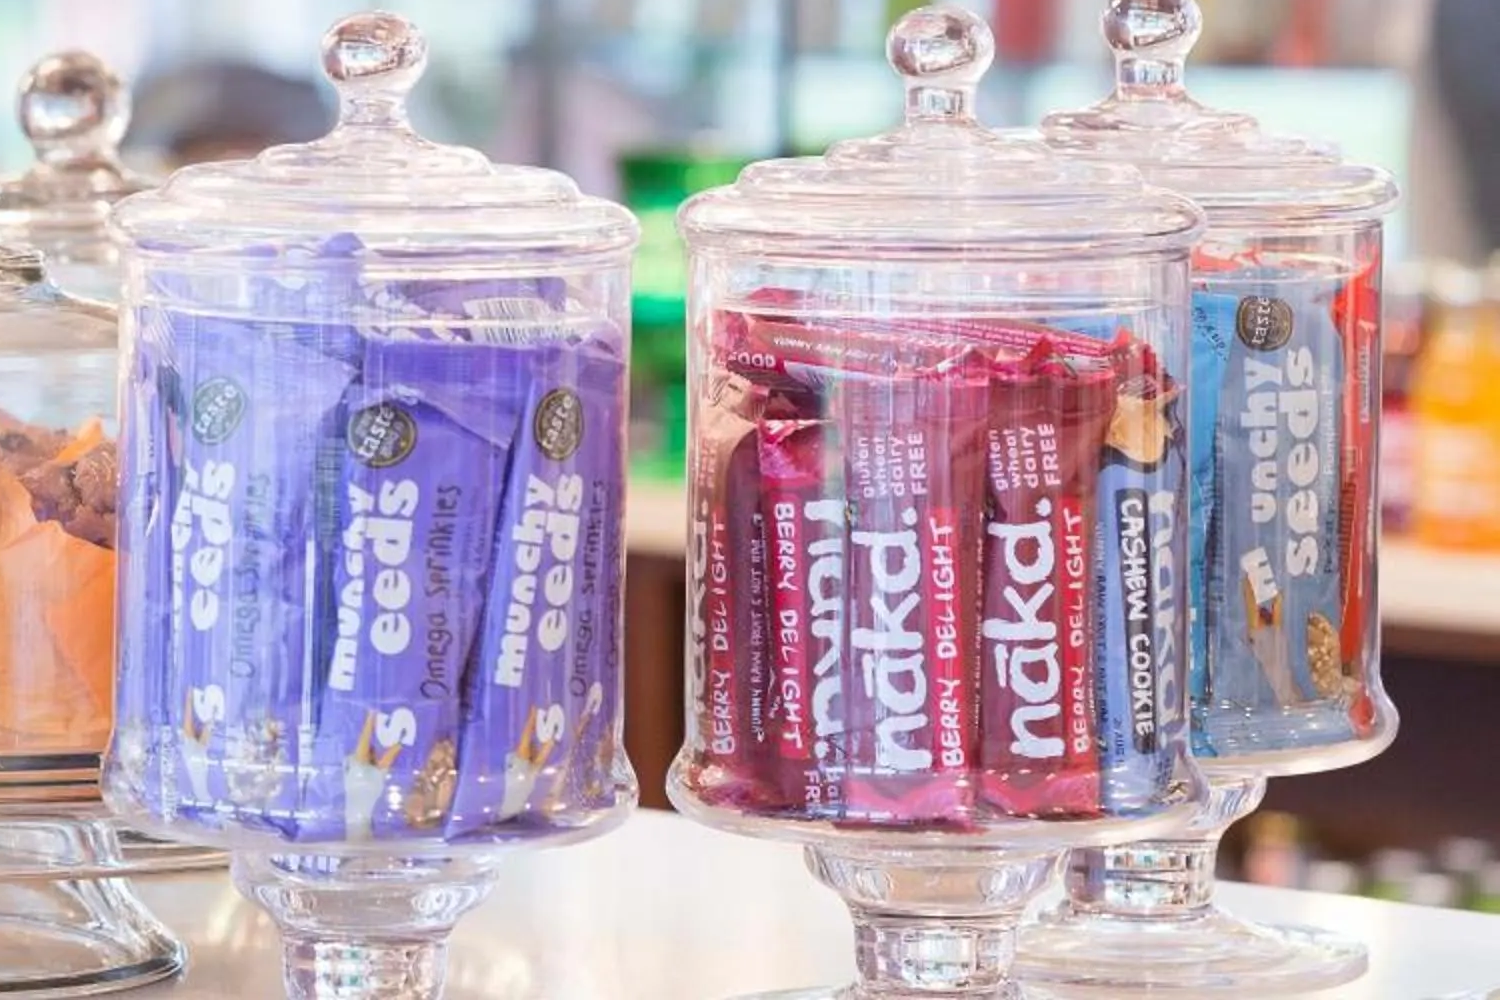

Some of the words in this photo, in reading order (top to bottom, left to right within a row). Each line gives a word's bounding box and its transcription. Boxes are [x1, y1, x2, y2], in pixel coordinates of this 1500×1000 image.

[357, 406, 397, 460] taste
[855, 436, 876, 500] gluten
[873, 436, 889, 497] wheat
[887, 433, 907, 498] dairy
[908, 431, 929, 495] FREE
[987, 428, 1010, 491] gluten
[1004, 427, 1022, 489] wheat
[1019, 426, 1040, 489] dairy
[1038, 423, 1062, 486] FREE
[1280, 346, 1320, 577] seeds
[328, 481, 375, 692] munchy
[494, 474, 555, 689] munchy
[710, 511, 730, 651] DELIGHT
[775, 502, 798, 592] BERRY
[929, 516, 957, 659] DELIGHT
[1062, 506, 1085, 647] DELIGHT
[1120, 498, 1149, 622] CASHEW
[420, 611, 453, 700] Omega
[568, 607, 594, 698] Omega
[779, 609, 803, 749] DELIGHT
[1128, 632, 1156, 738] COOKIE
[712, 671, 736, 755] BERRY
[936, 678, 965, 767] BERRY
[1072, 665, 1091, 754] BERRY
